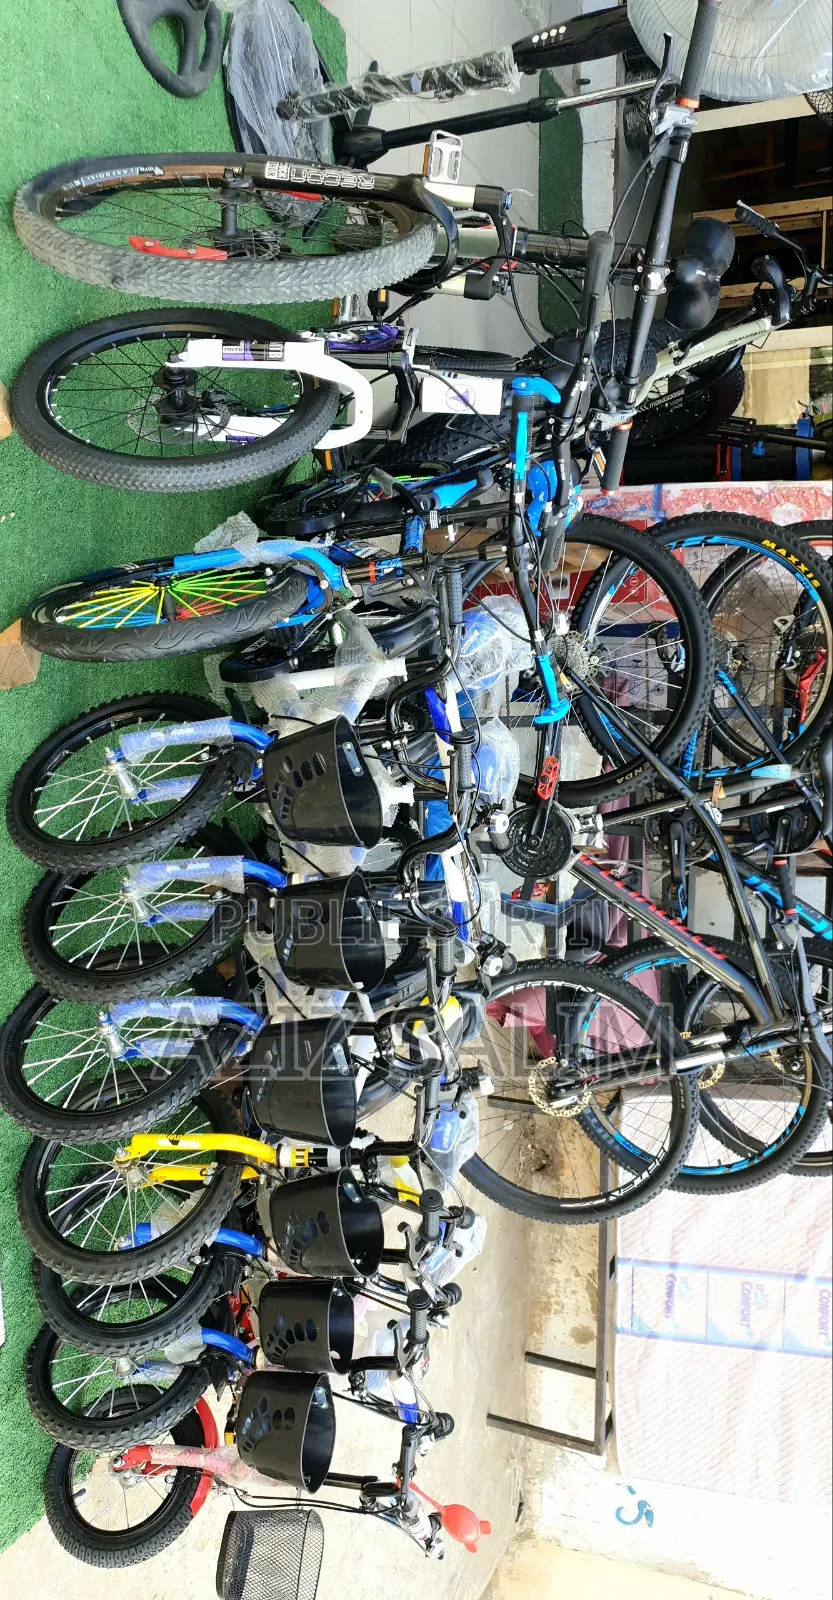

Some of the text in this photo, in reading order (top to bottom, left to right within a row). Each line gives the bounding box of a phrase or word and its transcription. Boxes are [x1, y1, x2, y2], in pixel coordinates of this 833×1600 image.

[289, 168, 375, 190] RECON
[761, 539, 821, 588] MAXXIS
[616, 761, 650, 784] ENDA
[740, 1282, 753, 1329] CONFORT
[818, 1289, 831, 1337] CONFORT
